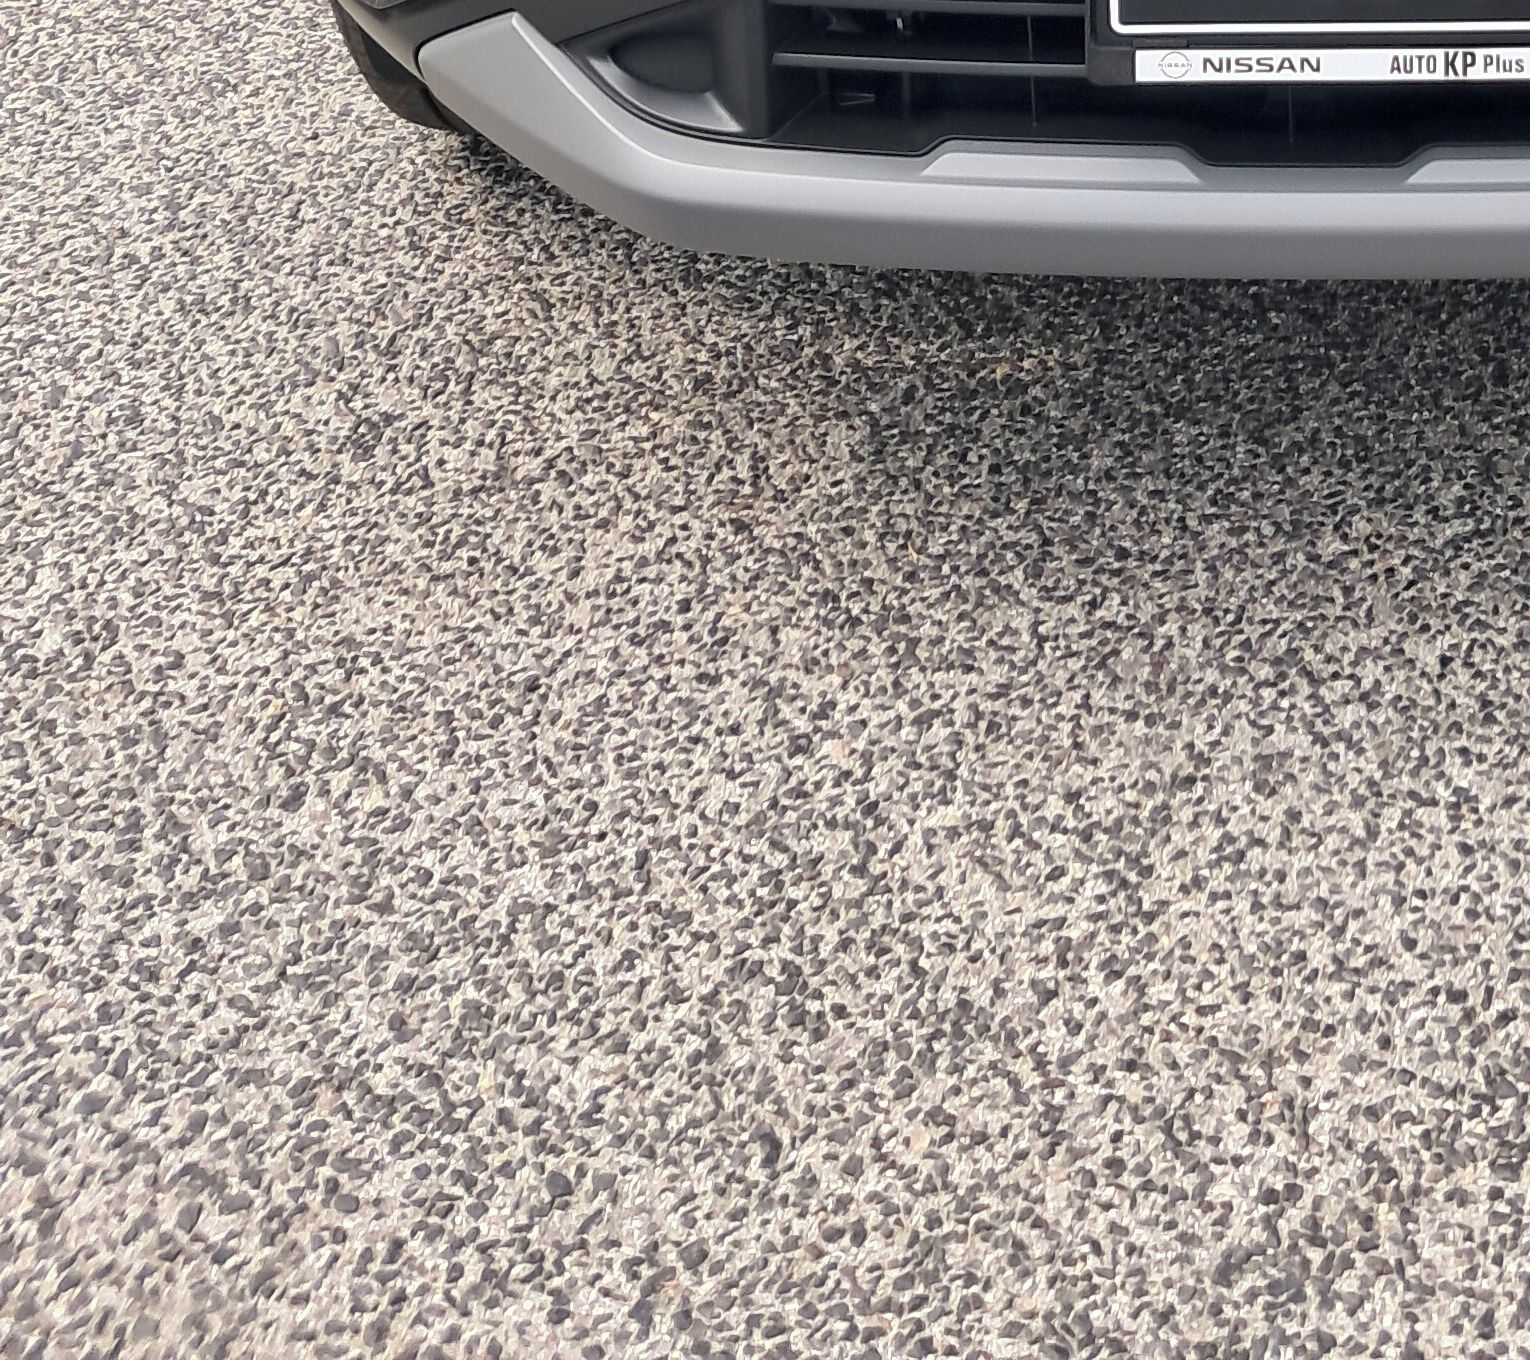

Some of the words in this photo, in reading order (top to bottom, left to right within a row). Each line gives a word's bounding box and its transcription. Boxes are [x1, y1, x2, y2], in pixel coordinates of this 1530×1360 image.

[1202, 56, 1321, 74] NISSAN
[1390, 54, 1437, 74] AUTO
[1443, 50, 1477, 78] KP
[1483, 53, 1525, 74] Plus
